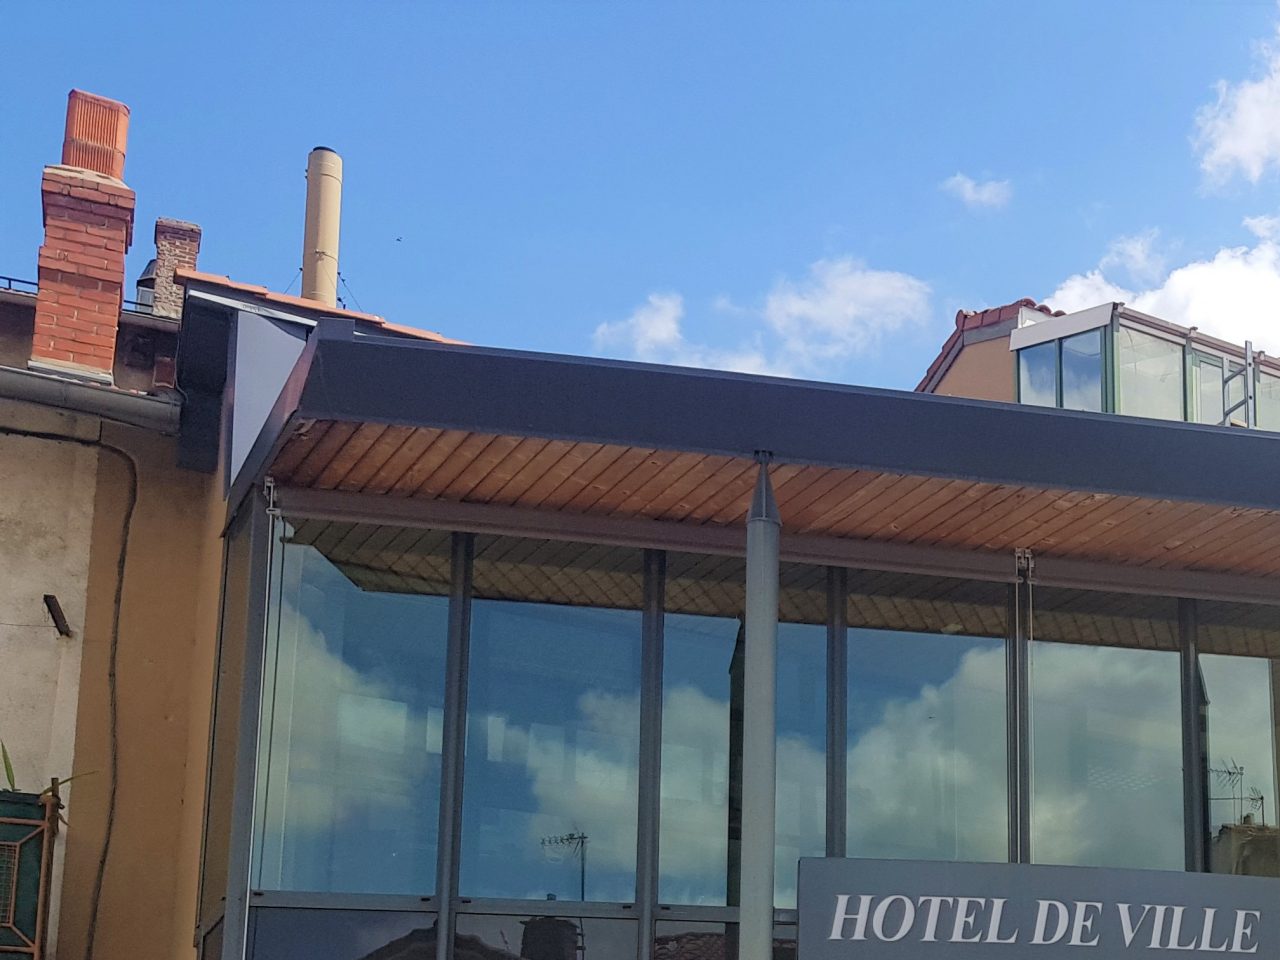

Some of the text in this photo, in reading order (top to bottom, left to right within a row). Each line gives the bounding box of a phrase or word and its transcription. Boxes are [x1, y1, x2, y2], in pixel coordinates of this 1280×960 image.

[828, 894, 1261, 953] HOTEL DE VILLE
